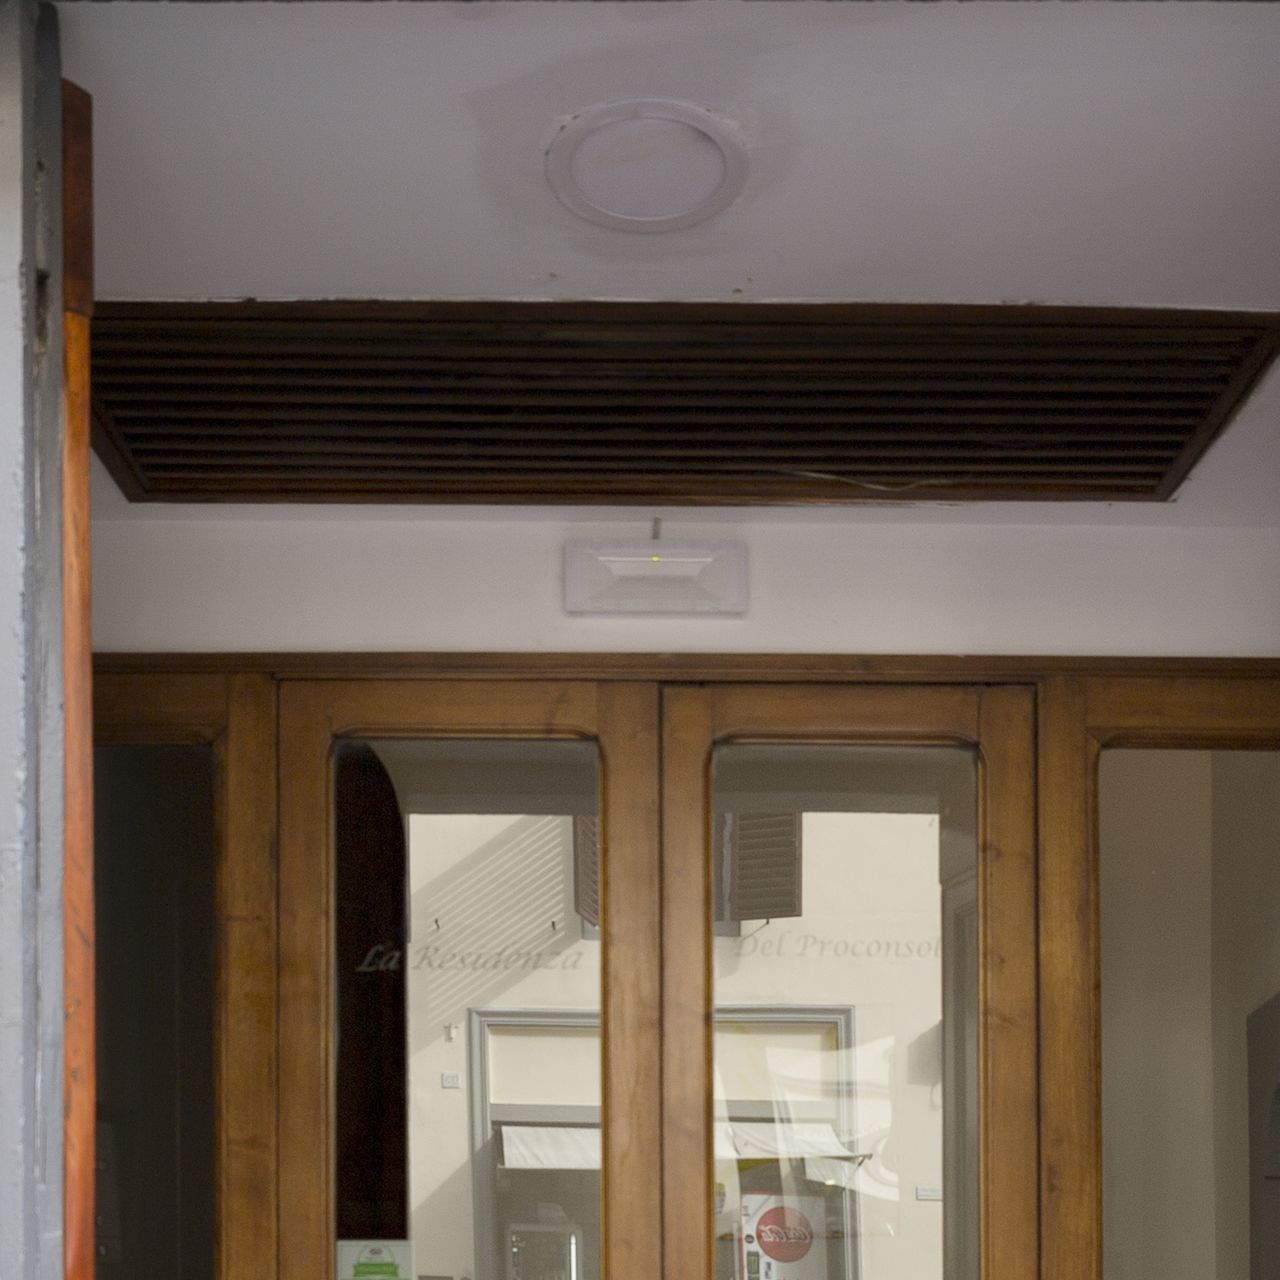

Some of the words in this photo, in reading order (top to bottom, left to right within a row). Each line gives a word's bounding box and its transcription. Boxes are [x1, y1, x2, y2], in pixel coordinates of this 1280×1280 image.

[355, 943, 402, 972] La
[410, 942, 584, 972] Residenza
[733, 931, 792, 958] Del
